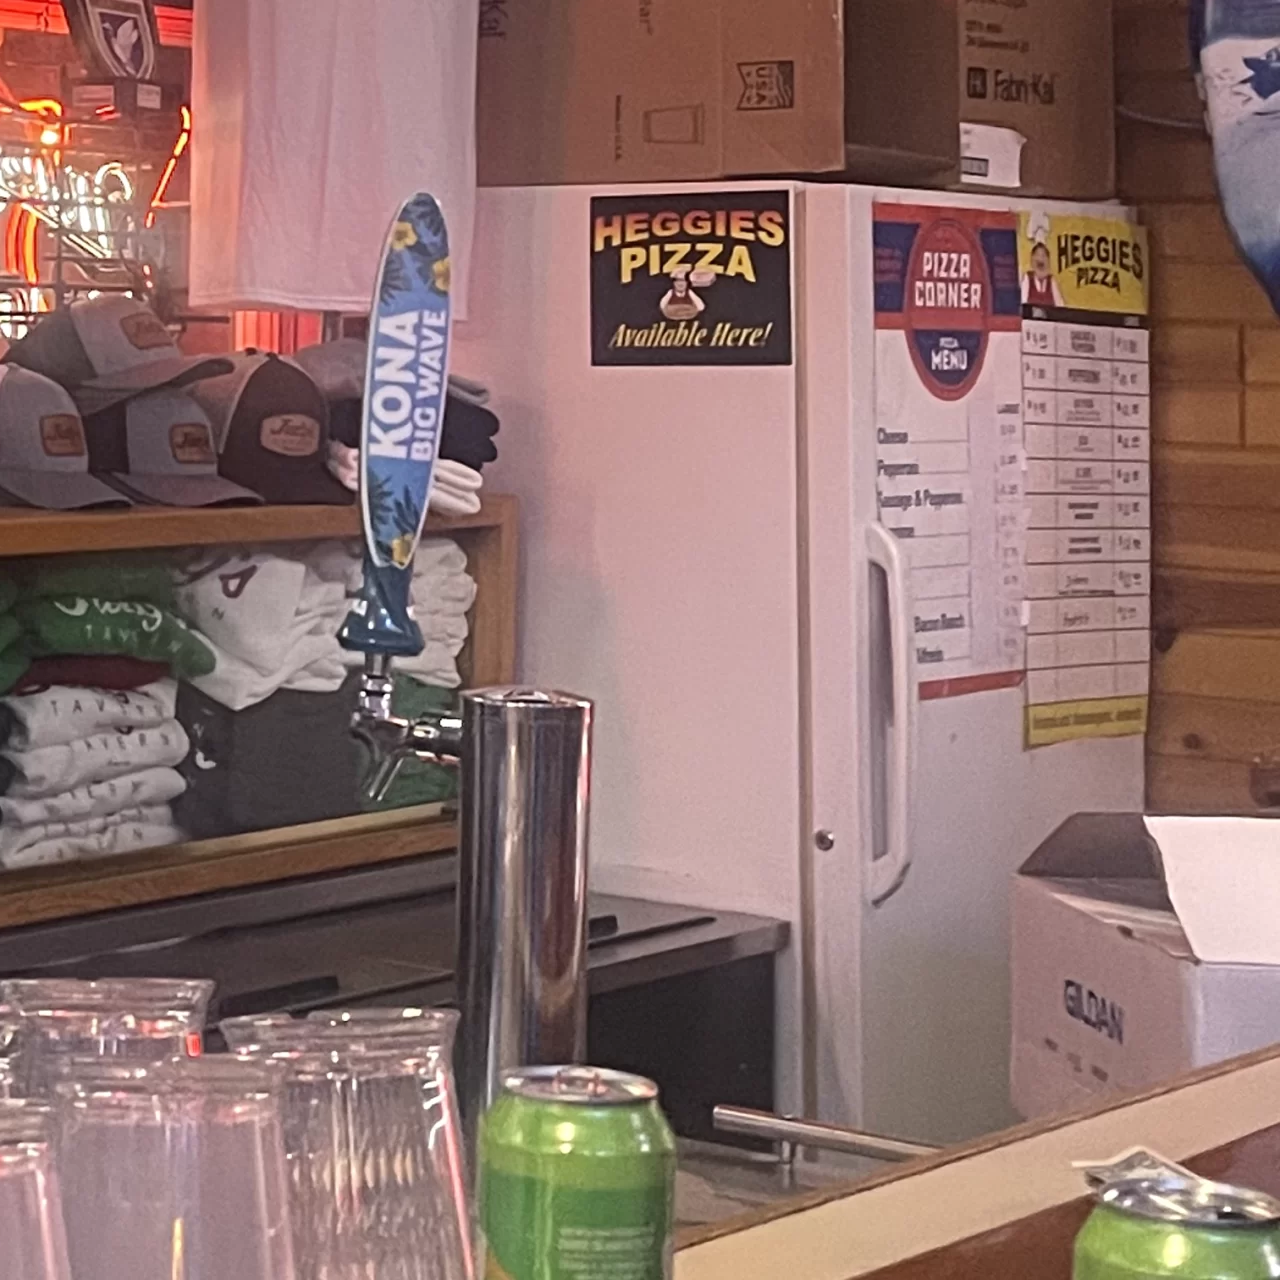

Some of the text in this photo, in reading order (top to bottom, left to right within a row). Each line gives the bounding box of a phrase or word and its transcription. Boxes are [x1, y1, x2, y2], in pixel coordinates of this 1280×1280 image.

[754, 66, 768, 104] USA
[593, 209, 786, 253] HEGGIES
[620, 242, 757, 284] PIZZA
[922, 251, 971, 279] PIZZA
[1056, 233, 1144, 281] HEGGIES
[914, 280, 982, 309] CORNER
[1075, 267, 1121, 293] PIZZA
[608, 320, 774, 350] Available Here!
[930, 348, 968, 370] MENU
[368, 309, 421, 461] KONA
[410, 308, 448, 463] BIG WAVE
